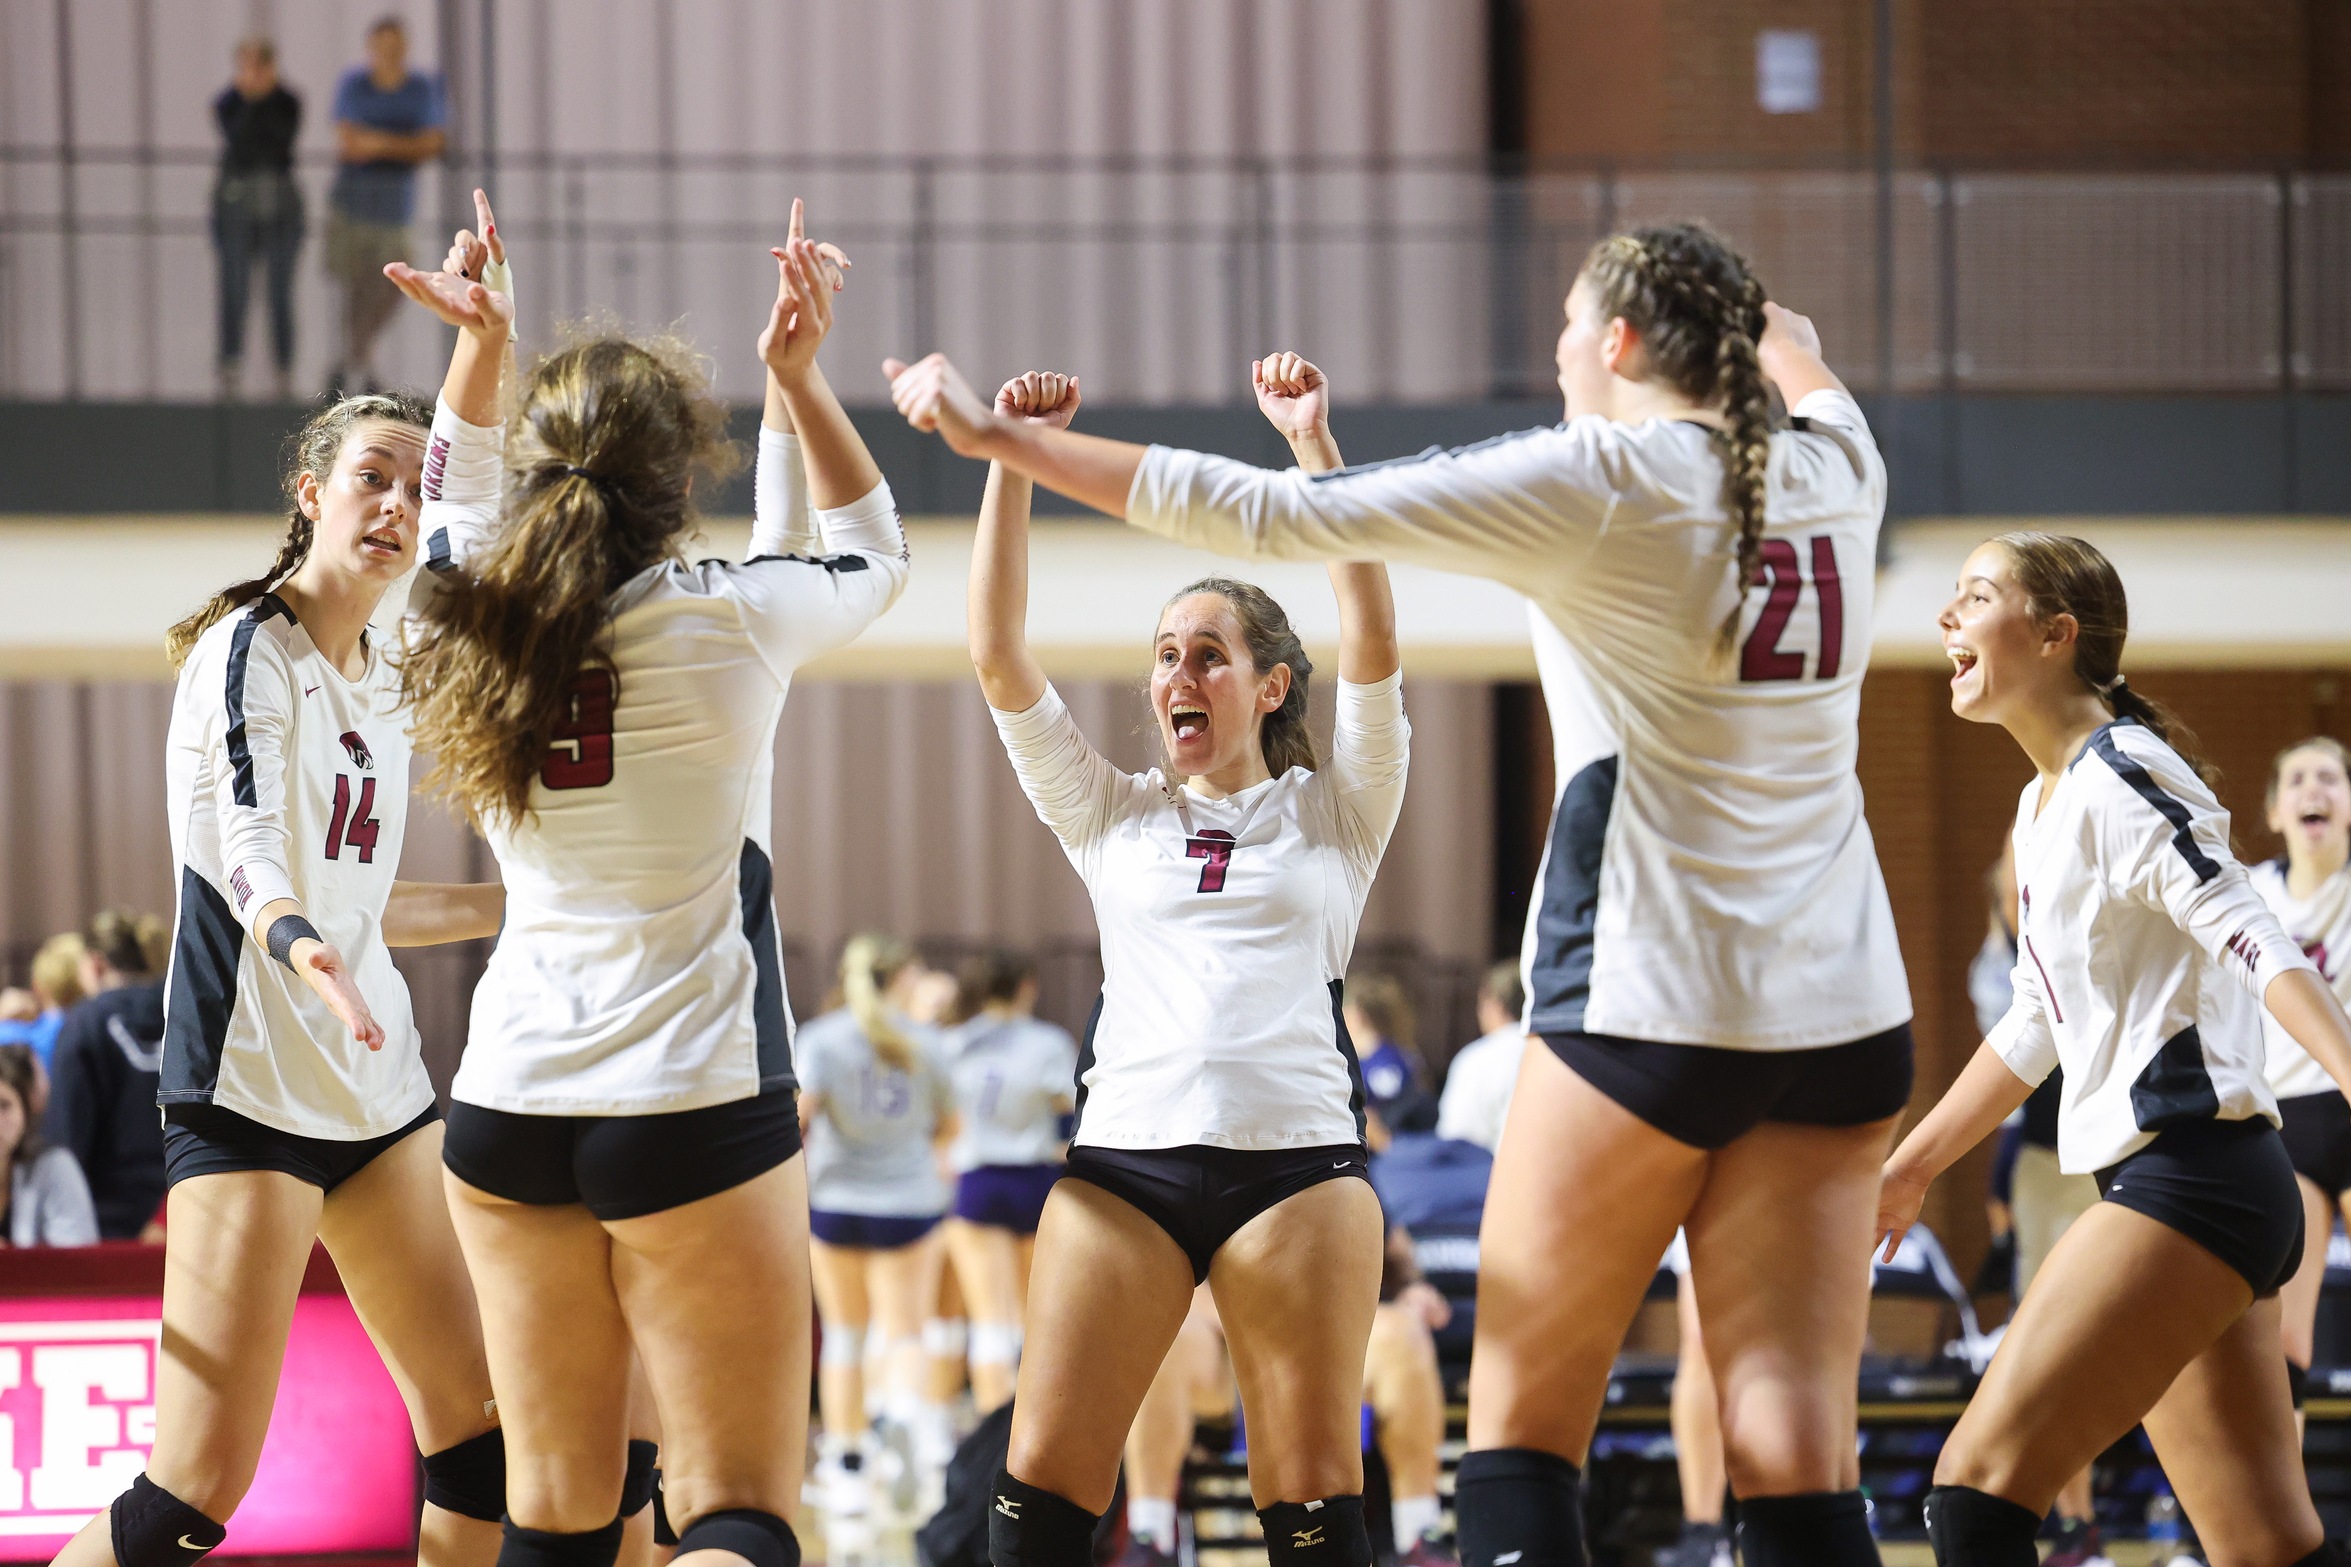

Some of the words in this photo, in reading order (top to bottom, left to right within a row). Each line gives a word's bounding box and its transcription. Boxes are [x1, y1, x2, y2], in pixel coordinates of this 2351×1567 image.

[1738, 535, 1843, 681] 21
[540, 668, 614, 791] 9
[325, 773, 380, 864] 14
[1185, 829, 1237, 893] 7
